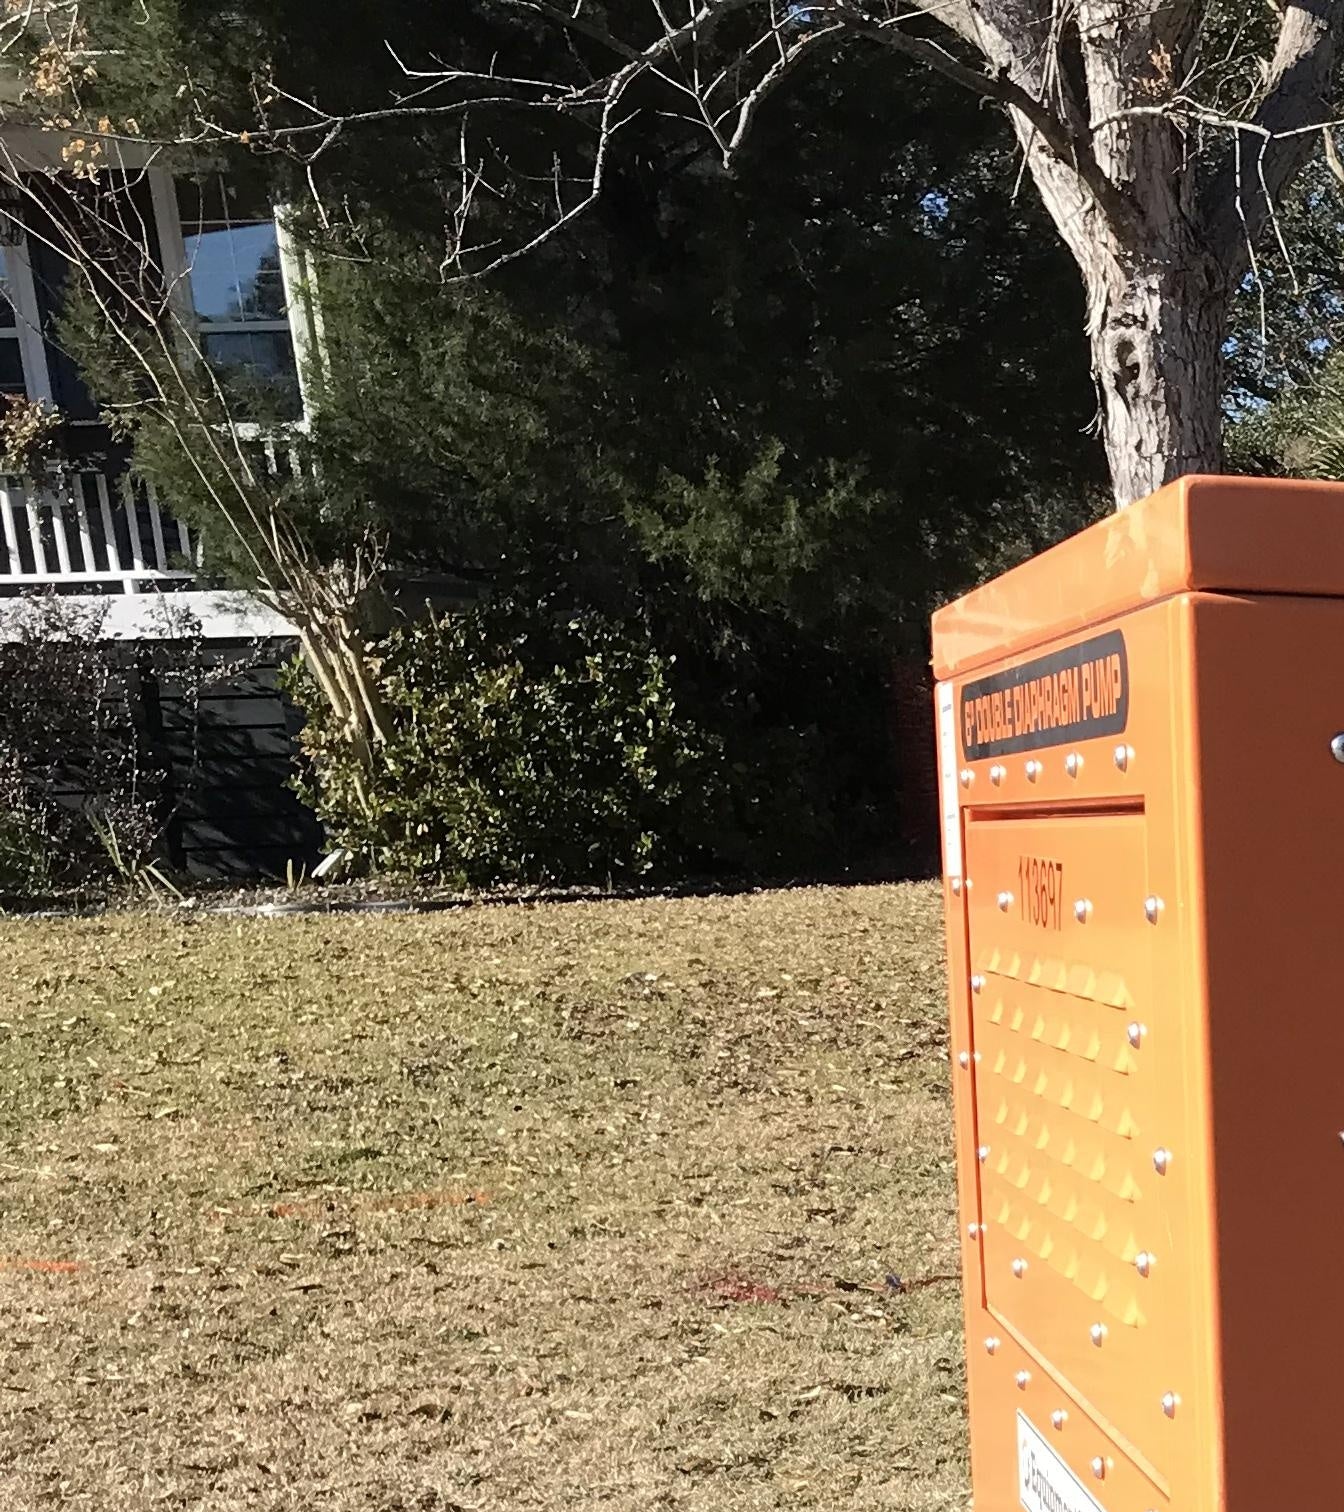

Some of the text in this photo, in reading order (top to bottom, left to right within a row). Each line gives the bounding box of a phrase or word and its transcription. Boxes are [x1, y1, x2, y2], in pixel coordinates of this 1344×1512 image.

[975, 688, 1013, 745] DOUBLE
[1013, 666, 1081, 737] DIAPHRAGM
[1081, 652, 1123, 721] PUMP
[1018, 855, 1063, 933] 113697
